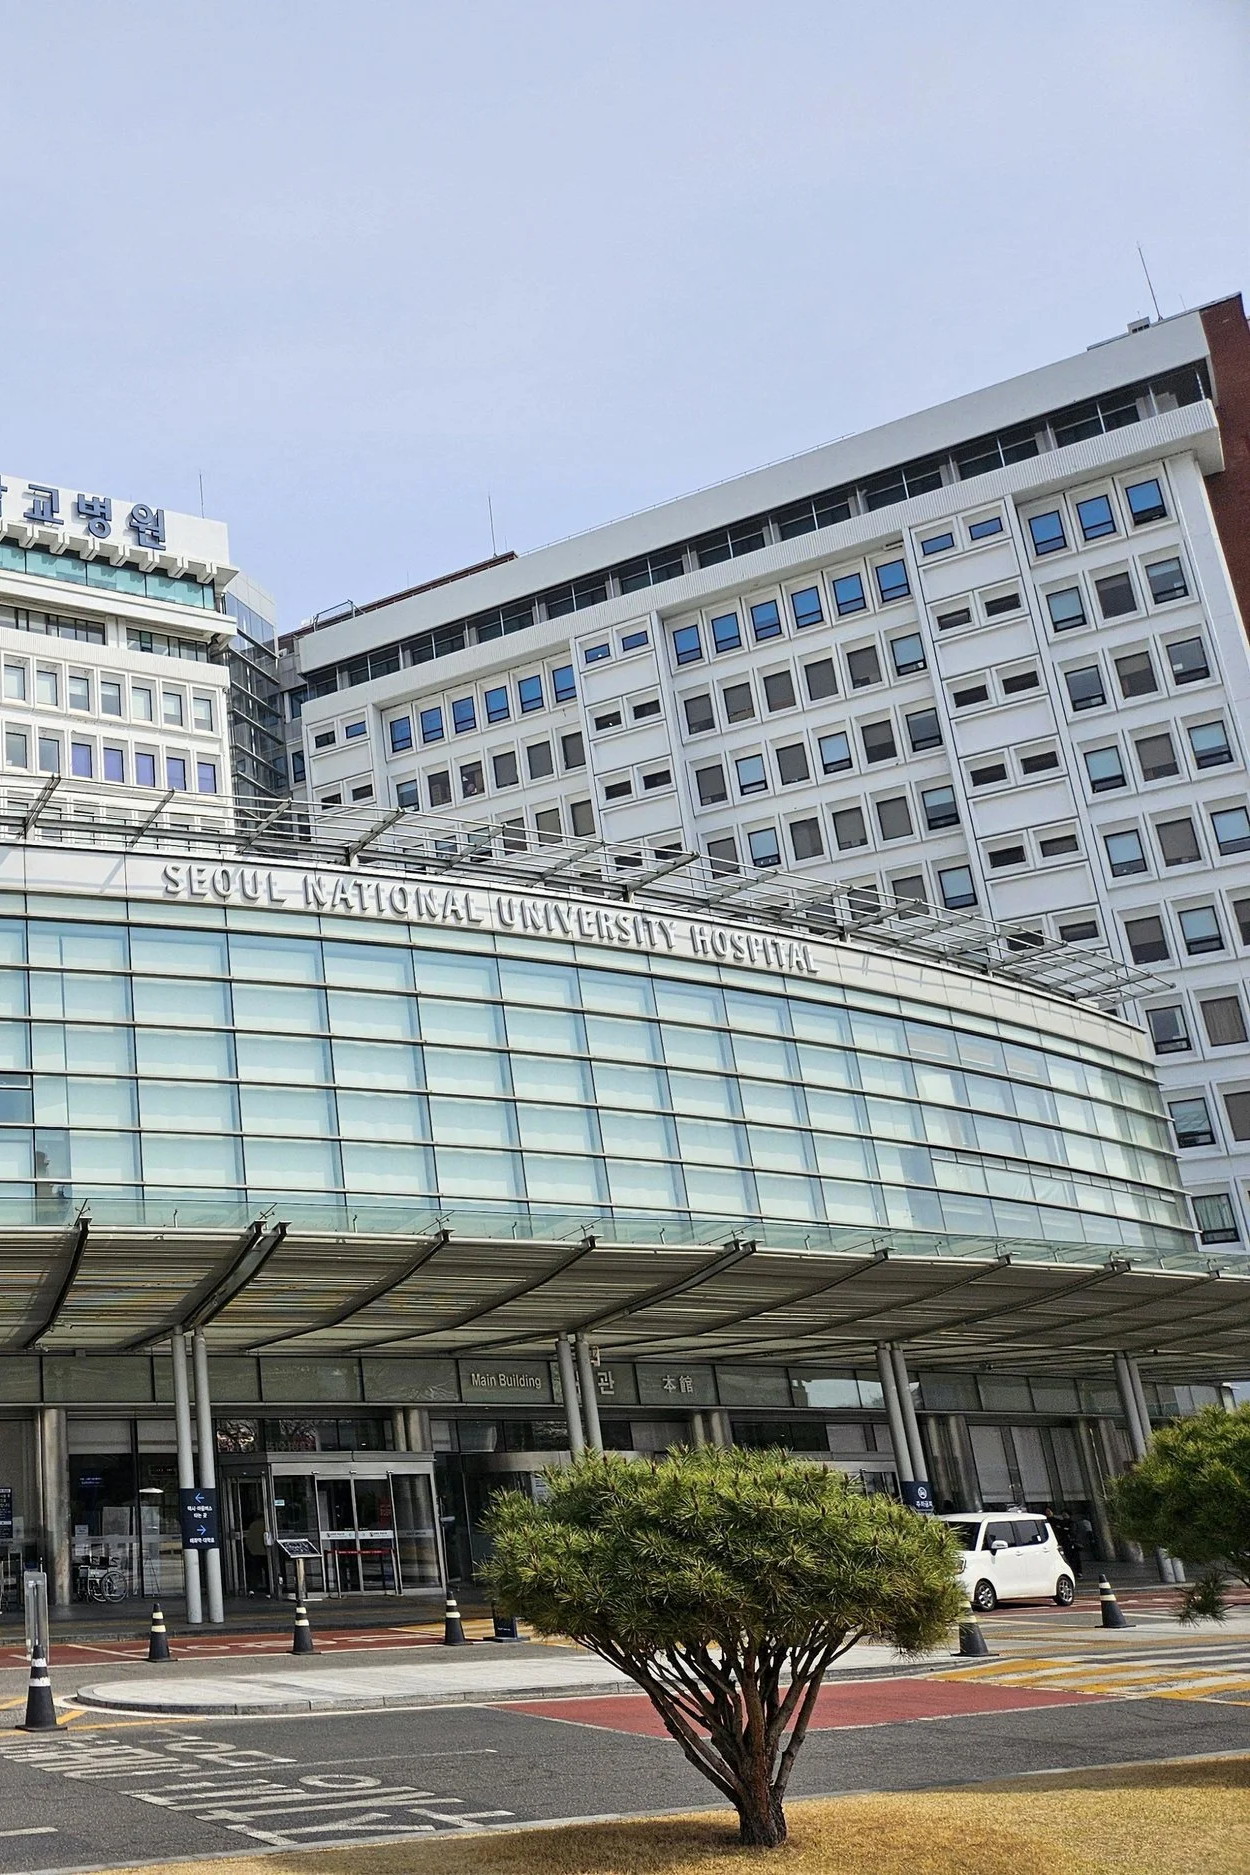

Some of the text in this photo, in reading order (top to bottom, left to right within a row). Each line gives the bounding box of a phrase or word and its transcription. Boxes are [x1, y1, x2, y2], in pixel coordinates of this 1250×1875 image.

[161, 863, 820, 974] SEOUL NATIONAL UNIVERSITY HOSPITAL
[471, 1373, 542, 1389] Main Building
